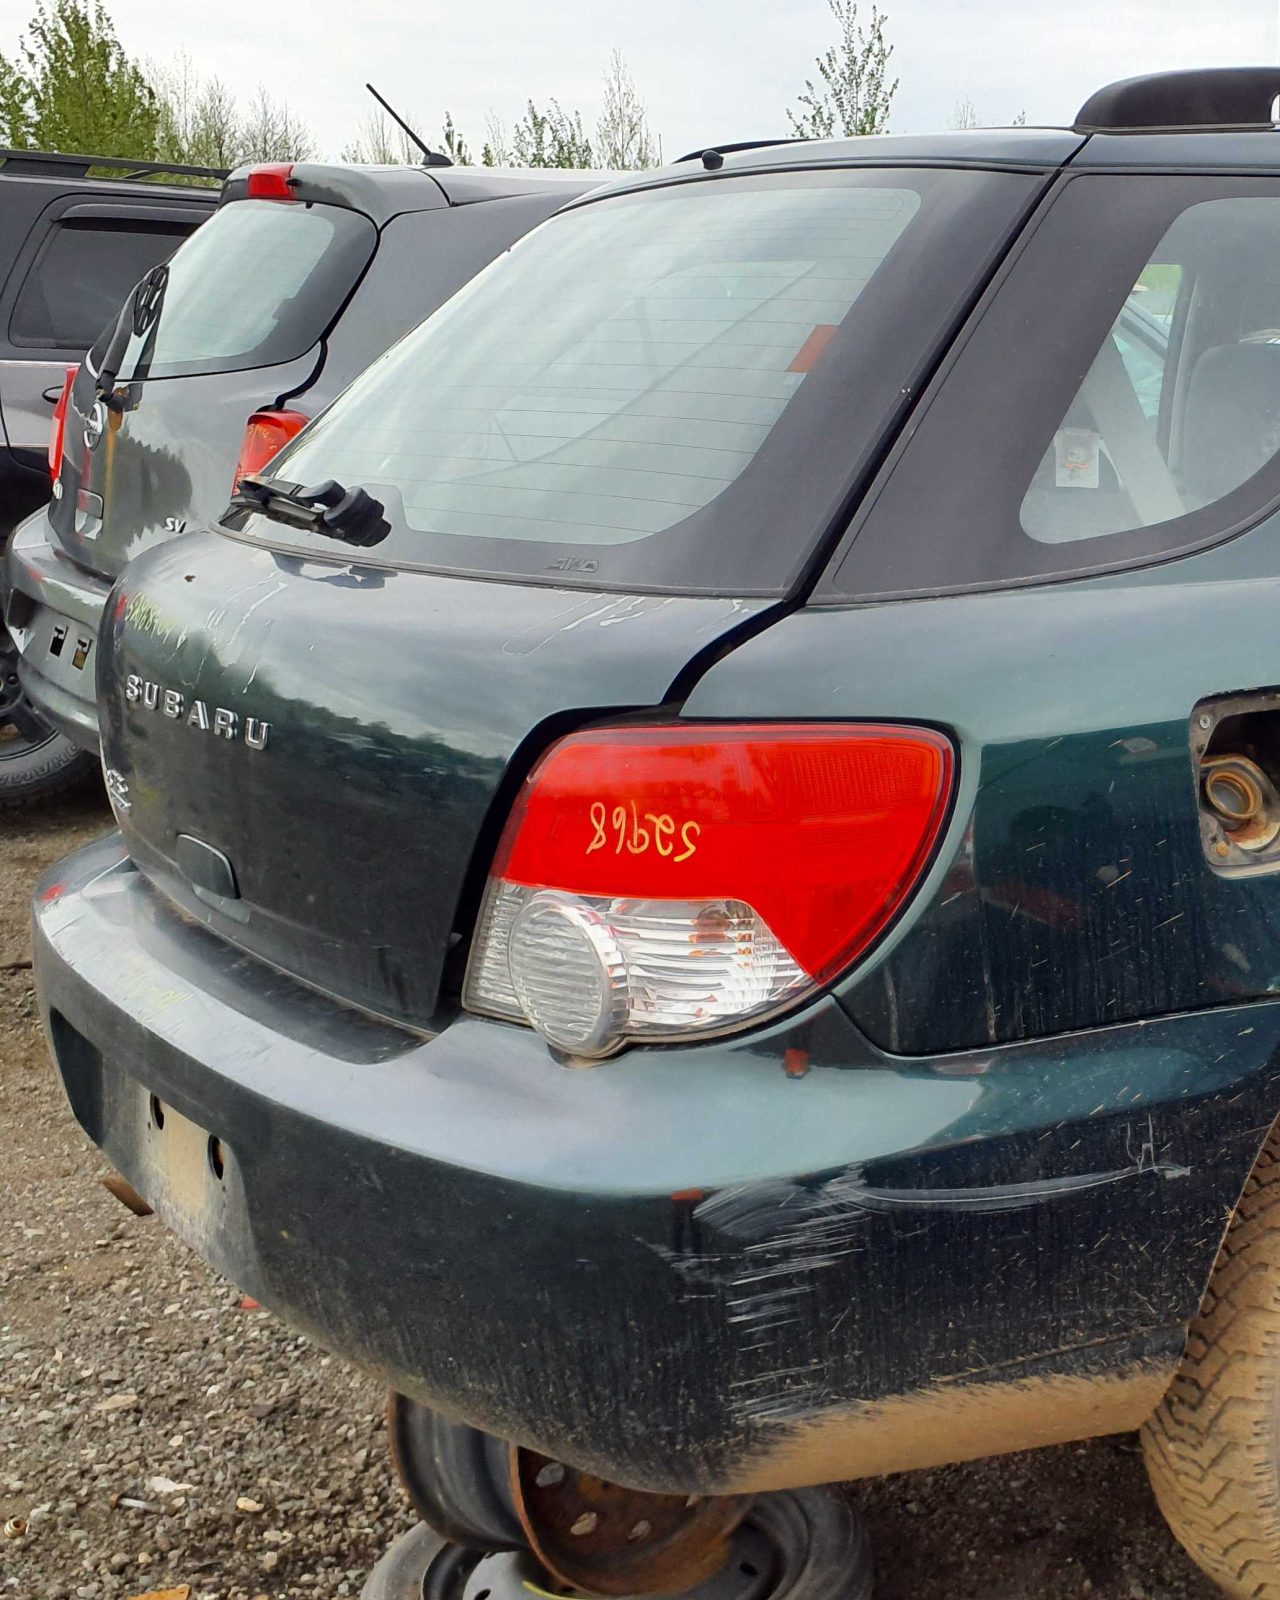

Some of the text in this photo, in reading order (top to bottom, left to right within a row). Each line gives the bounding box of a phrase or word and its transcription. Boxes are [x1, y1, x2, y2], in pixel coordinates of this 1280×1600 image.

[164, 517, 187, 534] SV
[126, 674, 272, 750] SUBARU
[585, 799, 701, 863] 52968
